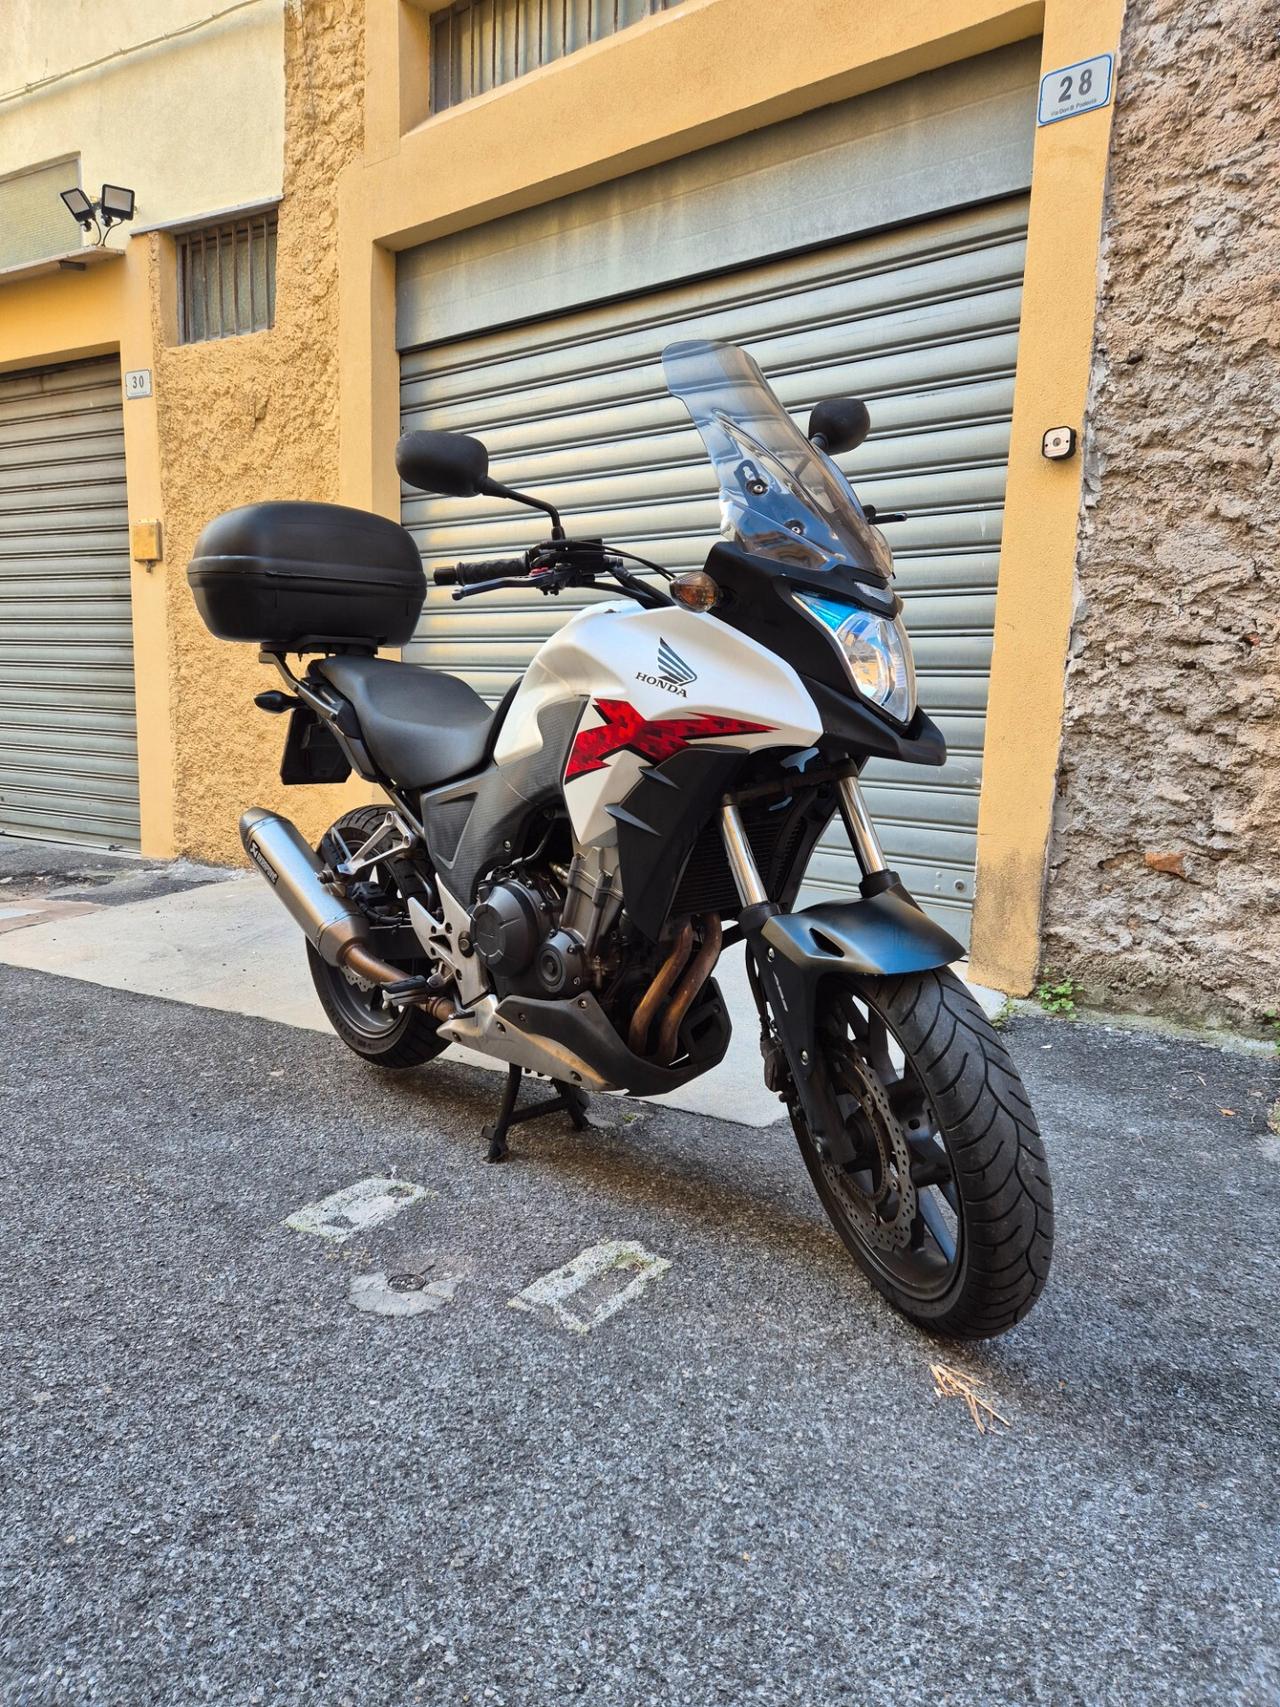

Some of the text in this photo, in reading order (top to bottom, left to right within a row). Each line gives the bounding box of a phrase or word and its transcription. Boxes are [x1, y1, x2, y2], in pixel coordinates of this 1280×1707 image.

[1058, 69, 1092, 103] 28
[132, 375, 144, 389] 30
[635, 671, 688, 699] HONDA
